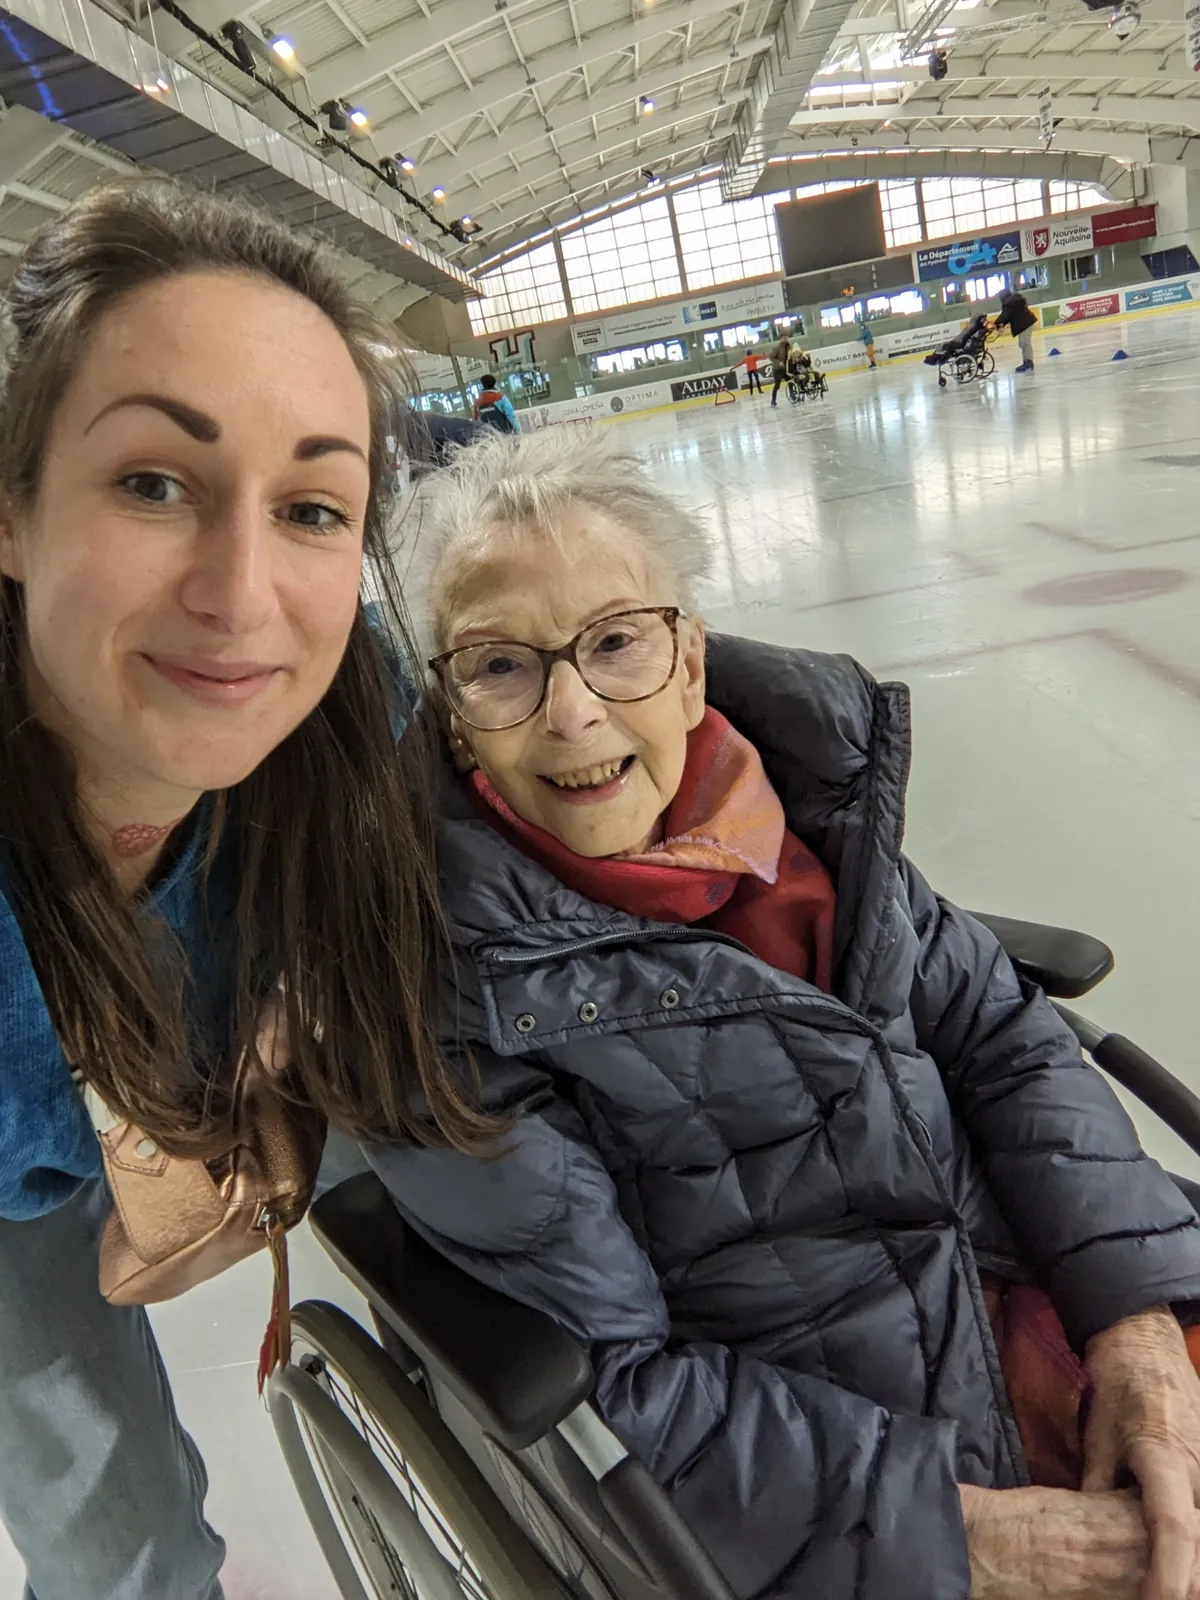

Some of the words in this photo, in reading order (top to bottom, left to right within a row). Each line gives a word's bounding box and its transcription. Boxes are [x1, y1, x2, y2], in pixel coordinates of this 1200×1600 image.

[1053, 226, 1092, 240] Nouvelle-
[1054, 233, 1092, 248] Aquitaine
[919, 254, 928, 262] Le
[929, 244, 979, 260] Département
[823, 352, 852, 364] RENAULT
[852, 349, 885, 360] BAYNE
[681, 376, 727, 395] ALDAY
[625, 392, 660, 404] OPTIMA
